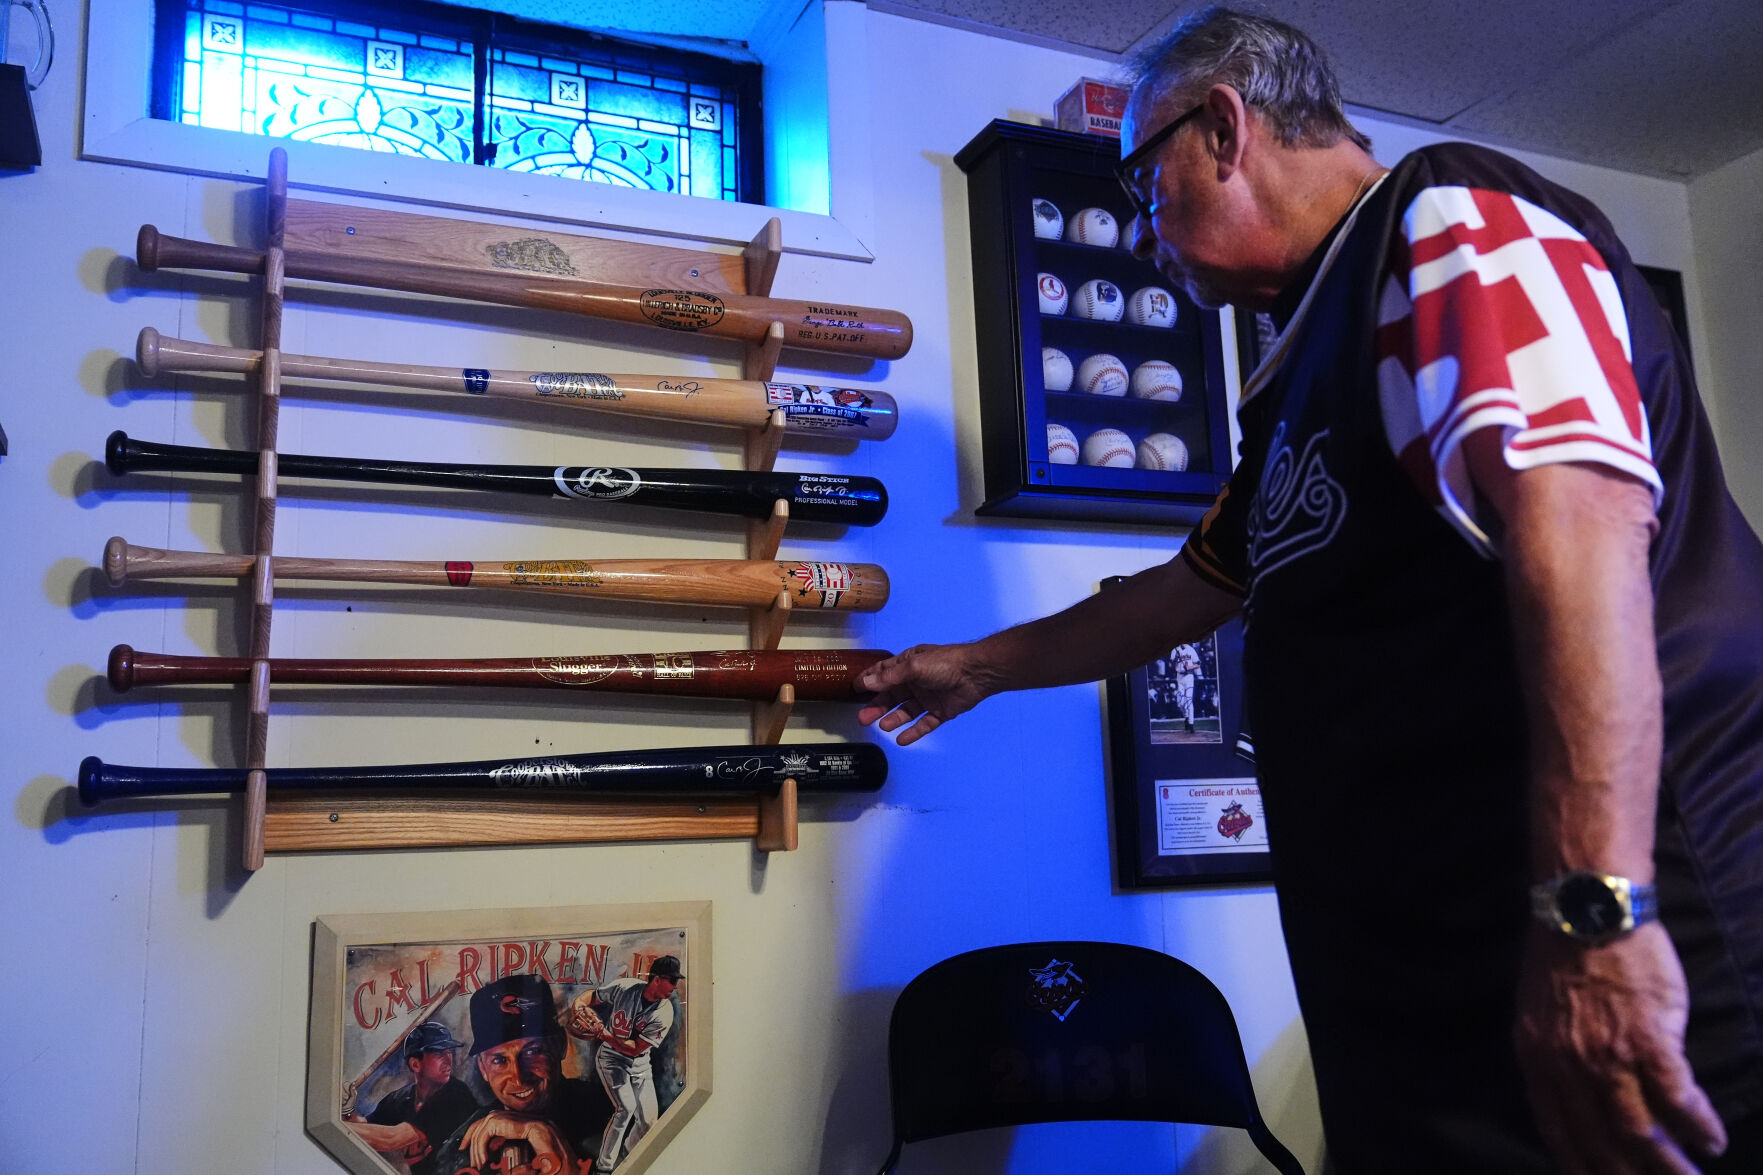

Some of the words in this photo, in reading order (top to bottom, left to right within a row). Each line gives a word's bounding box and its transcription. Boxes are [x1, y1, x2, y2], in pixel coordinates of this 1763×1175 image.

[674, 294, 691, 302] 125
[674, 303, 681, 311] &
[681, 303, 713, 315] BRADSBY
[807, 306, 859, 318] TRADEMARK
[789, 406, 808, 414] Ripken
[822, 406, 837, 416] Class
[794, 497, 838, 505] PROFESSIONAL
[549, 661, 603, 676] Slugger
[794, 664, 821, 672] LIMITED
[705, 765, 714, 778] 8
[1188, 787, 1226, 798] Certificate
[1226, 787, 1235, 796] of
[353, 958, 444, 1030] CAL
[456, 940, 611, 996] RIPKEN
